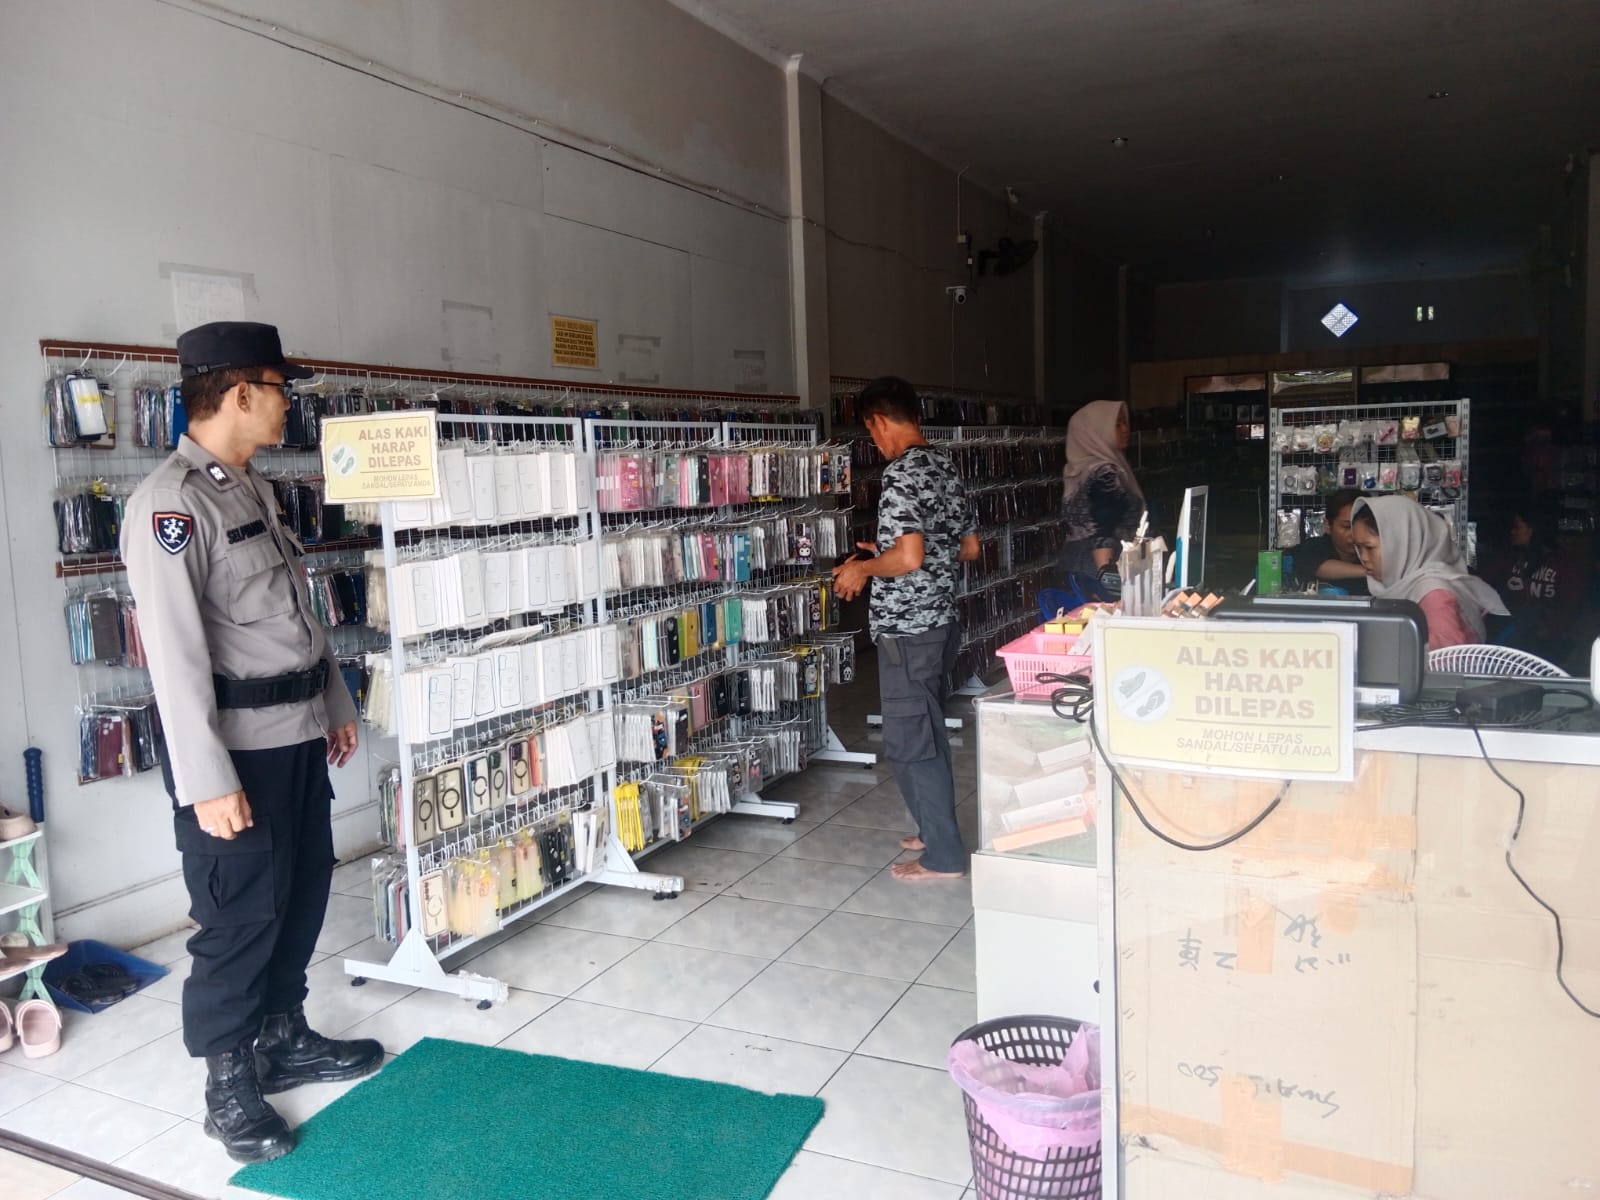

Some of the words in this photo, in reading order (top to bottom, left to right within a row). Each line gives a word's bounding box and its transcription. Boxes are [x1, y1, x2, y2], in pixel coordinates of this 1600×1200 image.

[358, 428, 391, 441] ALAS
[395, 425, 428, 439] KAKI
[371, 441, 416, 454] HARAP
[368, 455, 421, 468] DILEPAS
[1176, 646, 1249, 667] ALAS
[1259, 649, 1333, 669] KAKI
[1204, 672, 1304, 694] HARAP
[1194, 696, 1315, 719] DILEPAS
[1202, 728, 1256, 742] MOHON
[1258, 732, 1304, 745] LEPAS
[1176, 737, 1289, 755] SANDAL/SEPATU
[1291, 745, 1333, 757] ANDA
